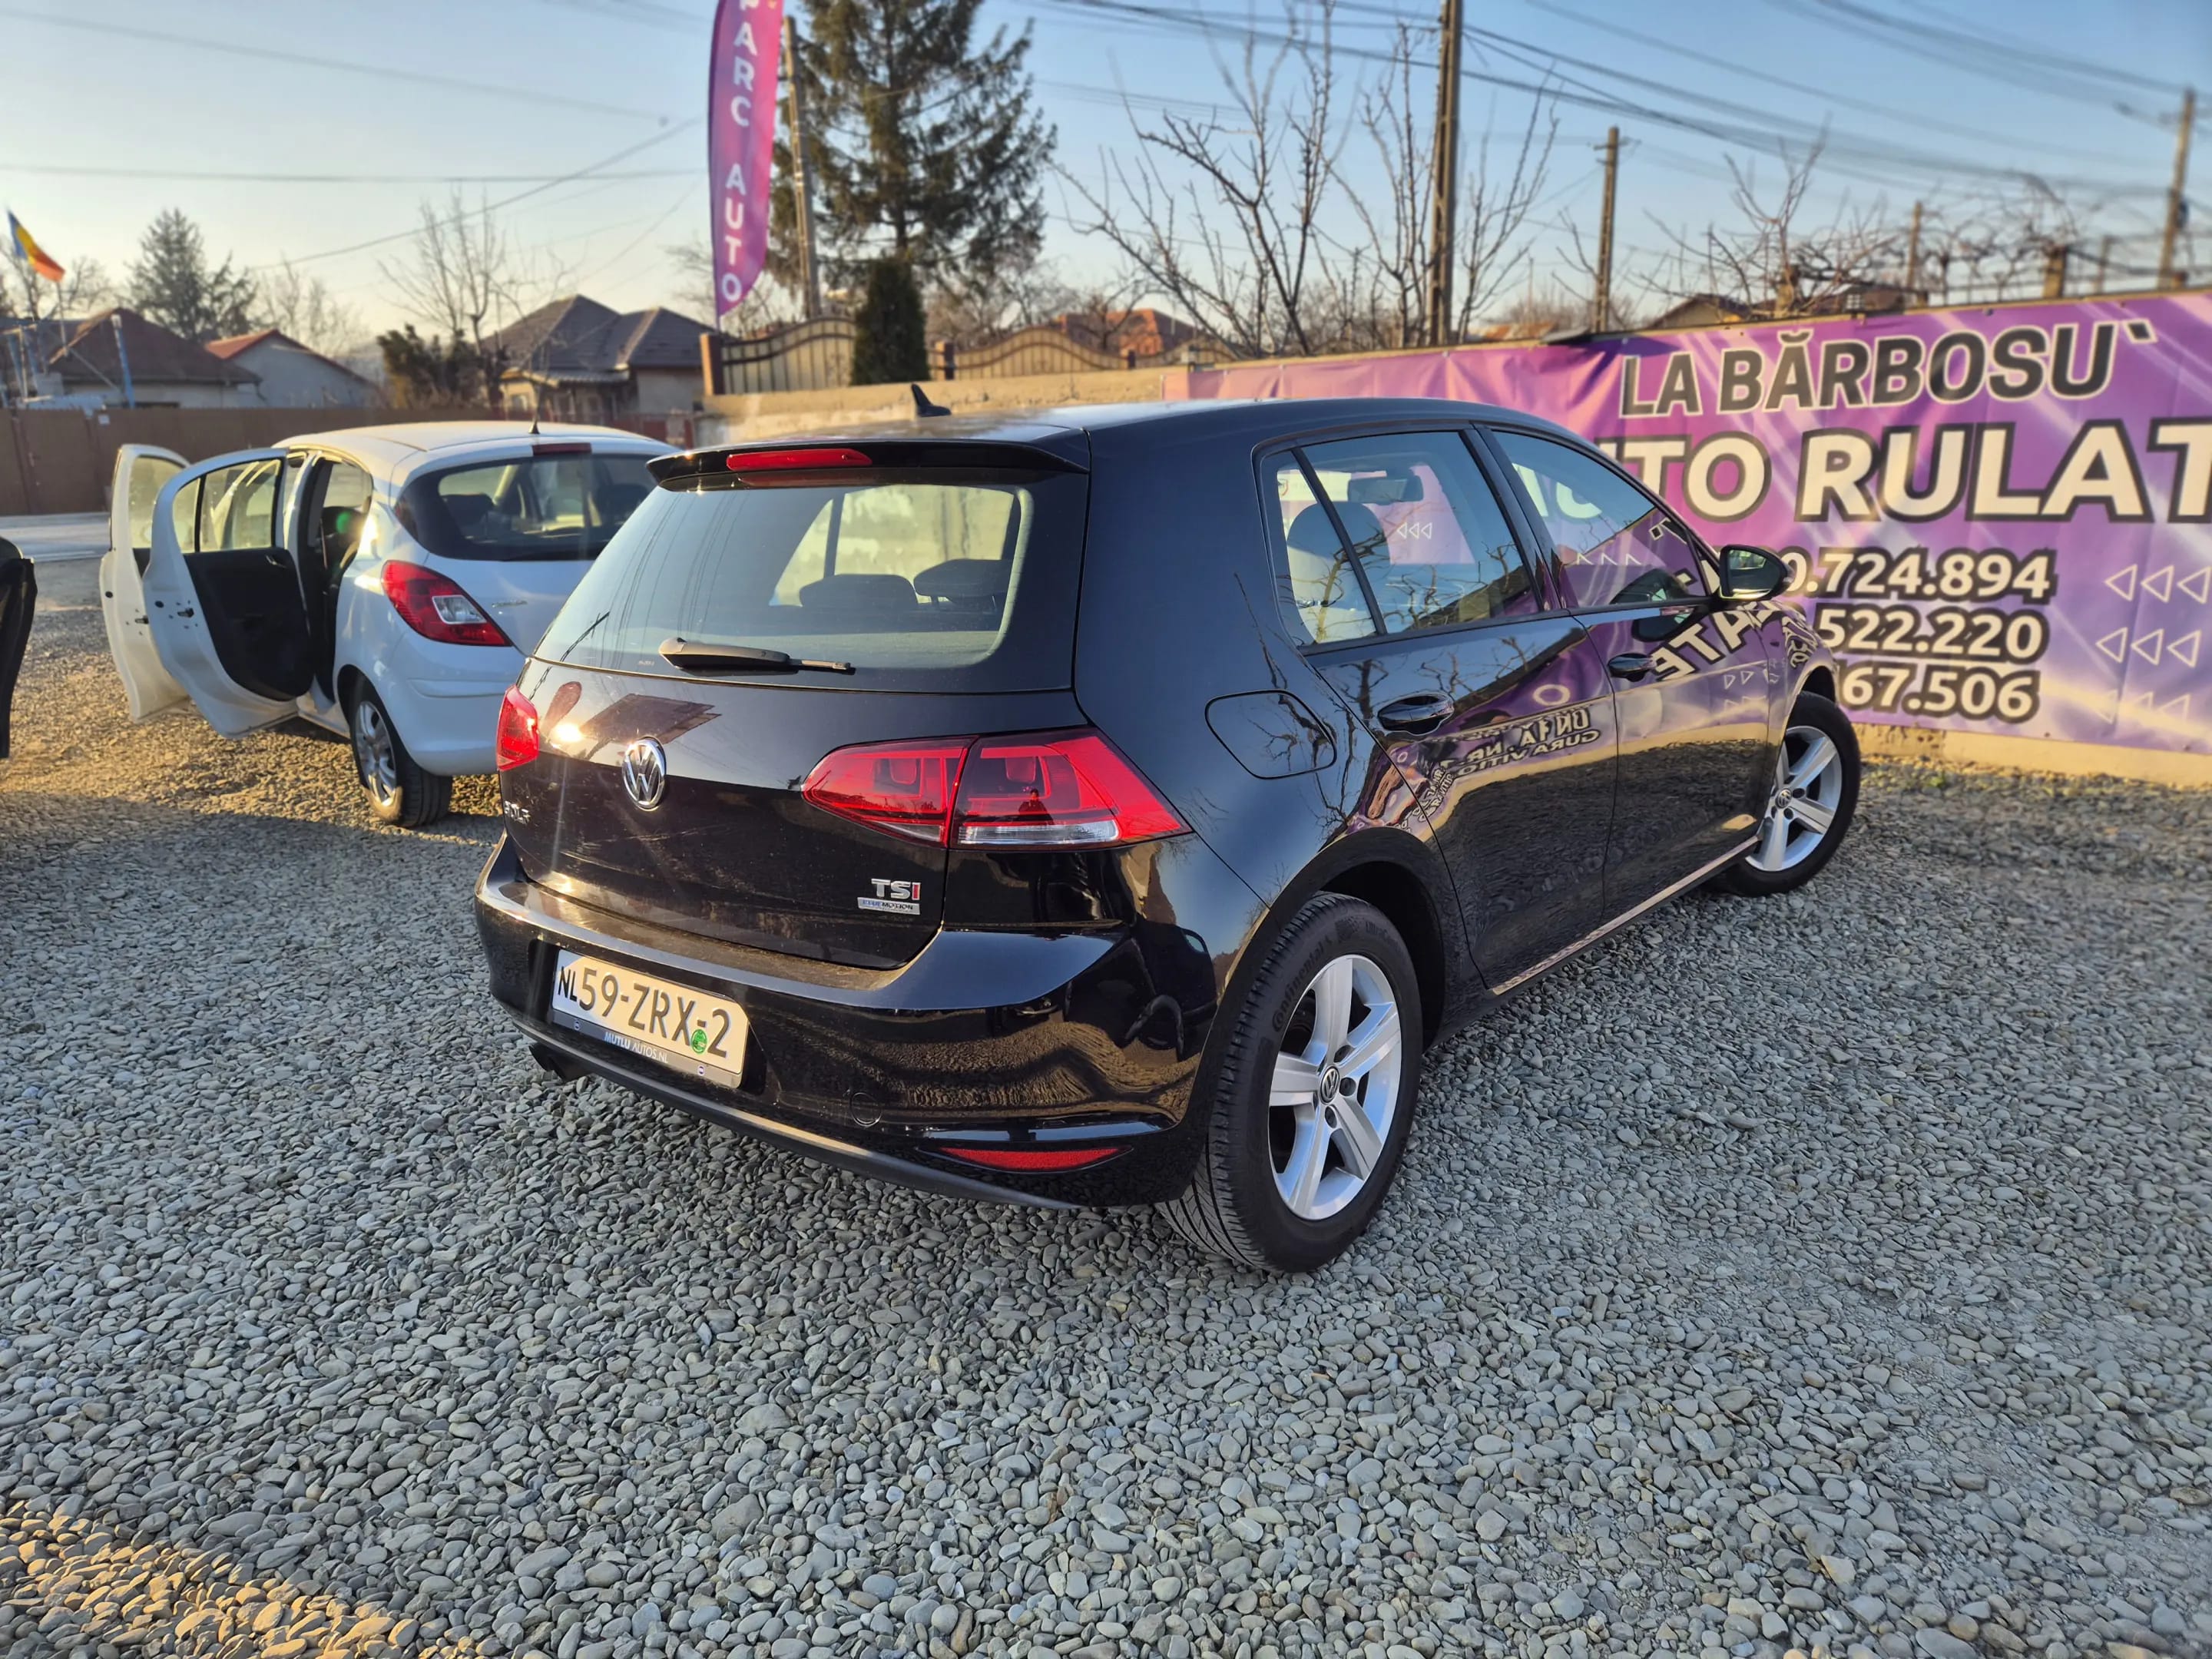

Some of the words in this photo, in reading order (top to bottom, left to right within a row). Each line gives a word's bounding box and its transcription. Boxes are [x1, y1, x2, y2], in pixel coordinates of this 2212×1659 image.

[721, 162, 746, 302] AUTO
[1619, 351, 1703, 418] LA
[558, 965, 578, 1002] NL
[579, 967, 730, 1058] 59-ZRX-2
[604, 1031, 631, 1050] MUTLU
